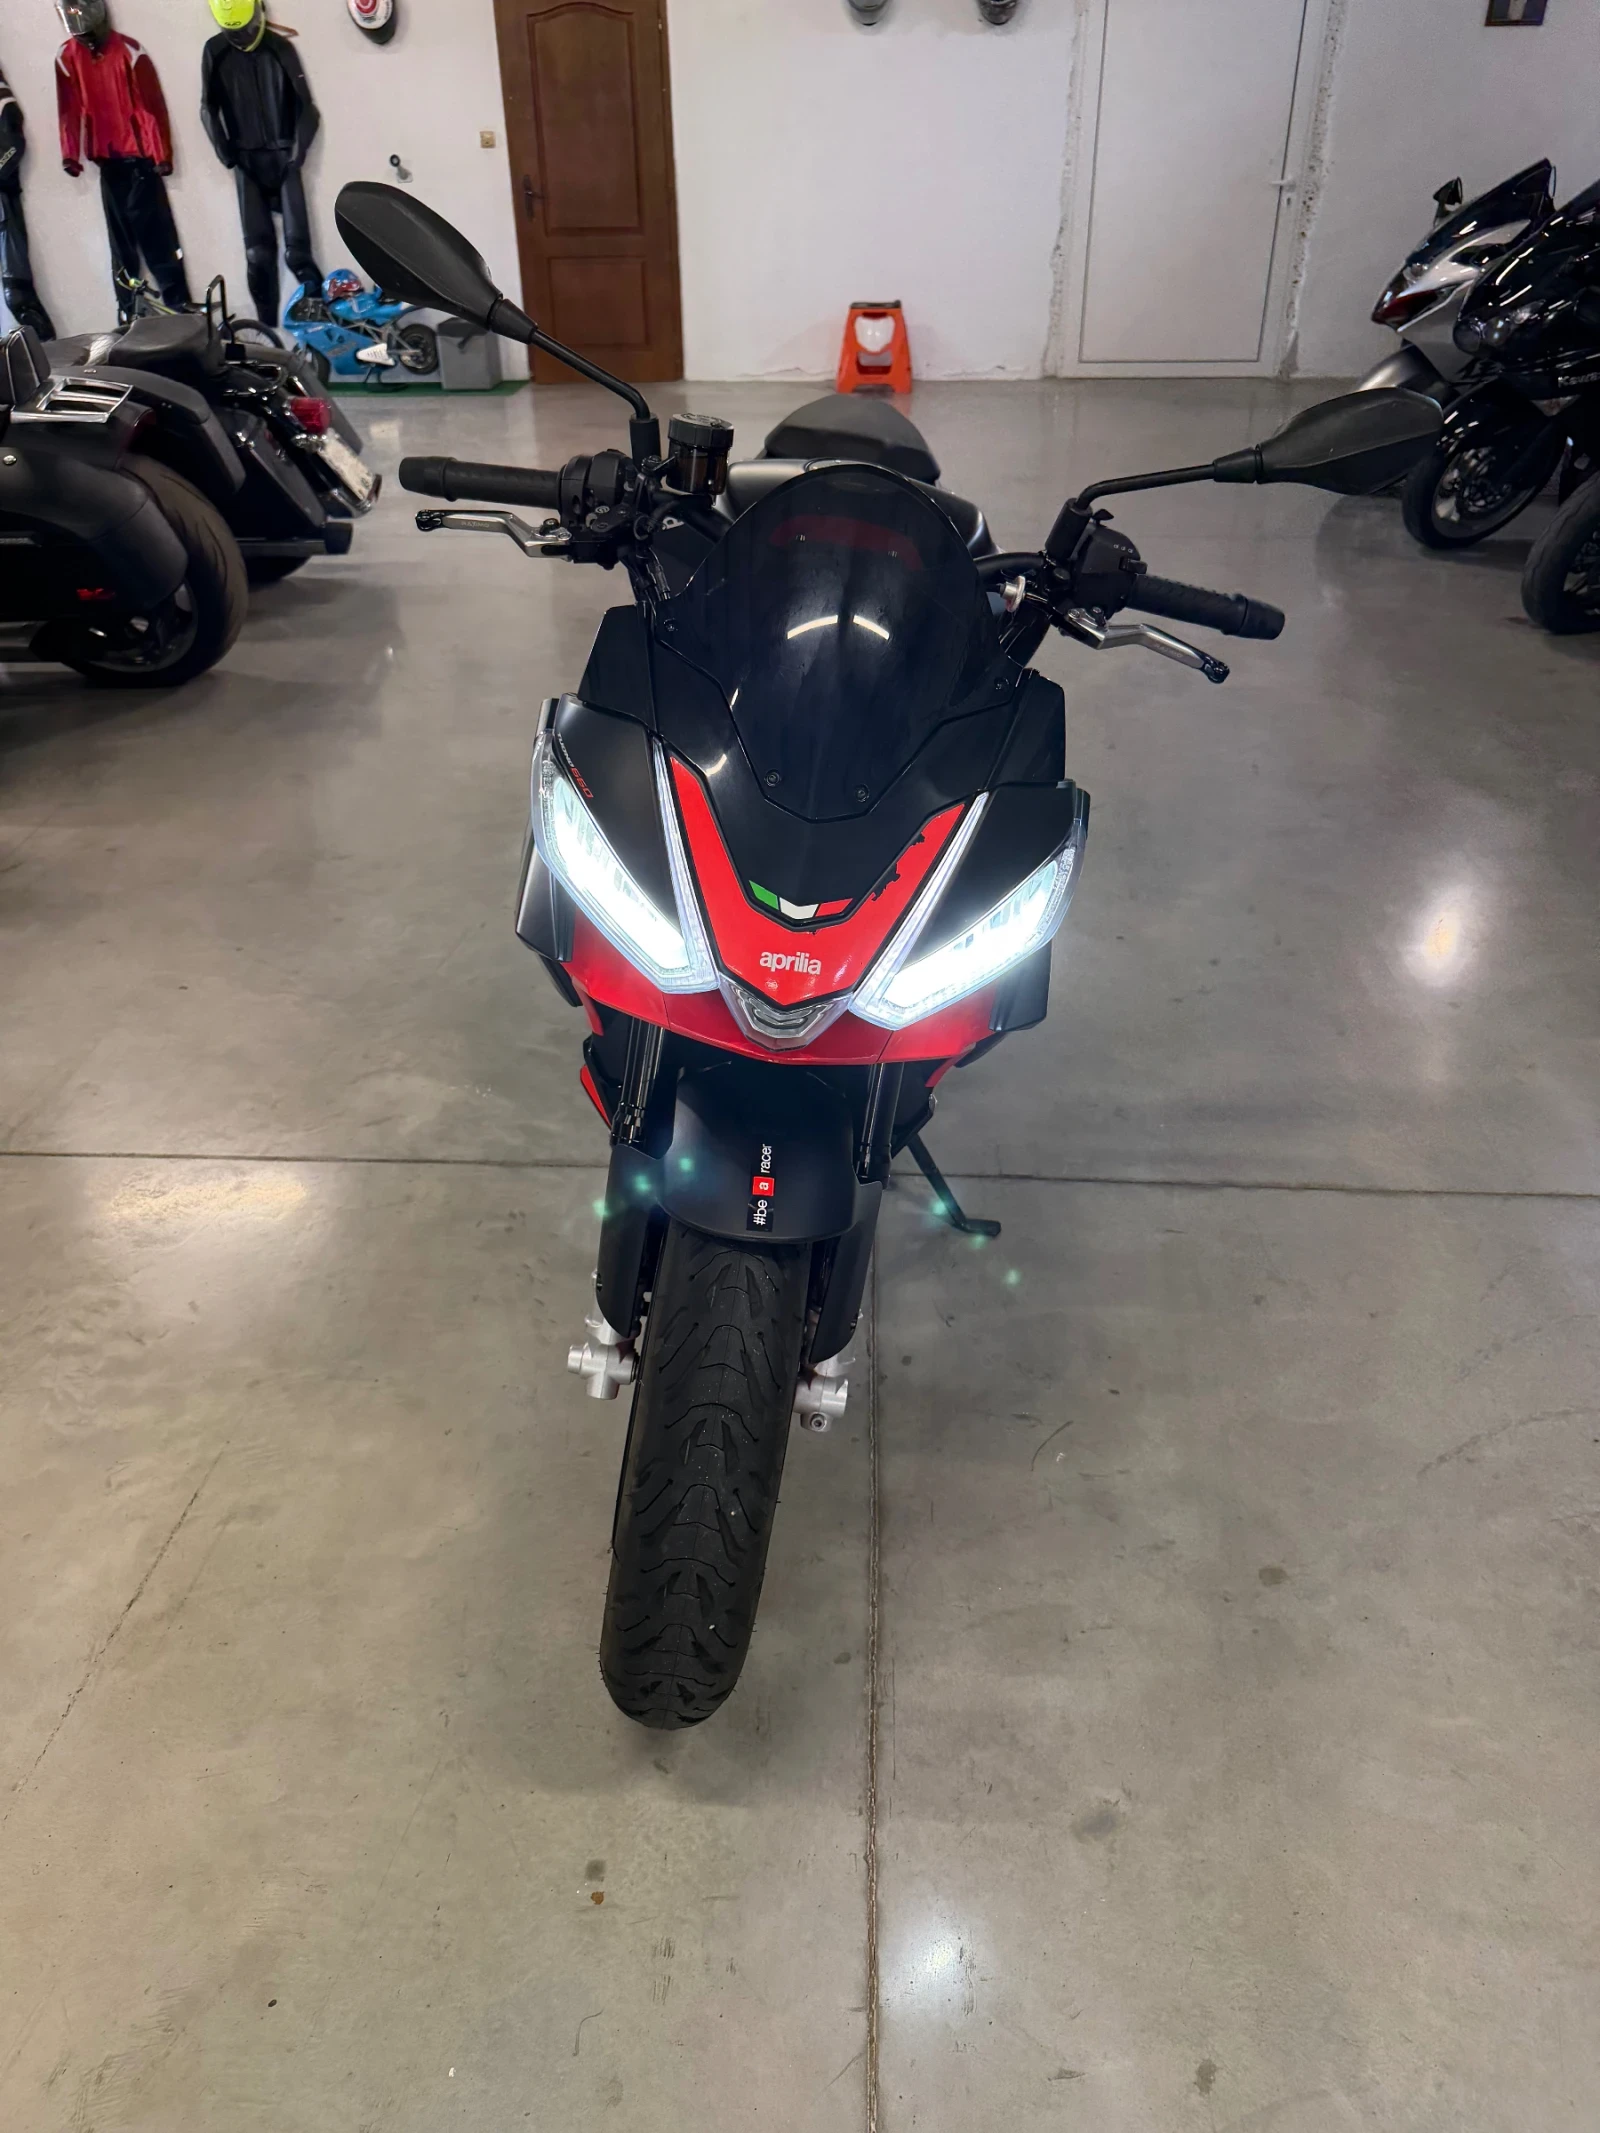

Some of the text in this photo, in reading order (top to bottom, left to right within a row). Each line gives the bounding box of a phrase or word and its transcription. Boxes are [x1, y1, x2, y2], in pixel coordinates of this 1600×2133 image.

[557, 732, 594, 799] TUONO 660
[759, 951, 823, 975] aprilia
[753, 1143, 773, 1227] #be a racer
